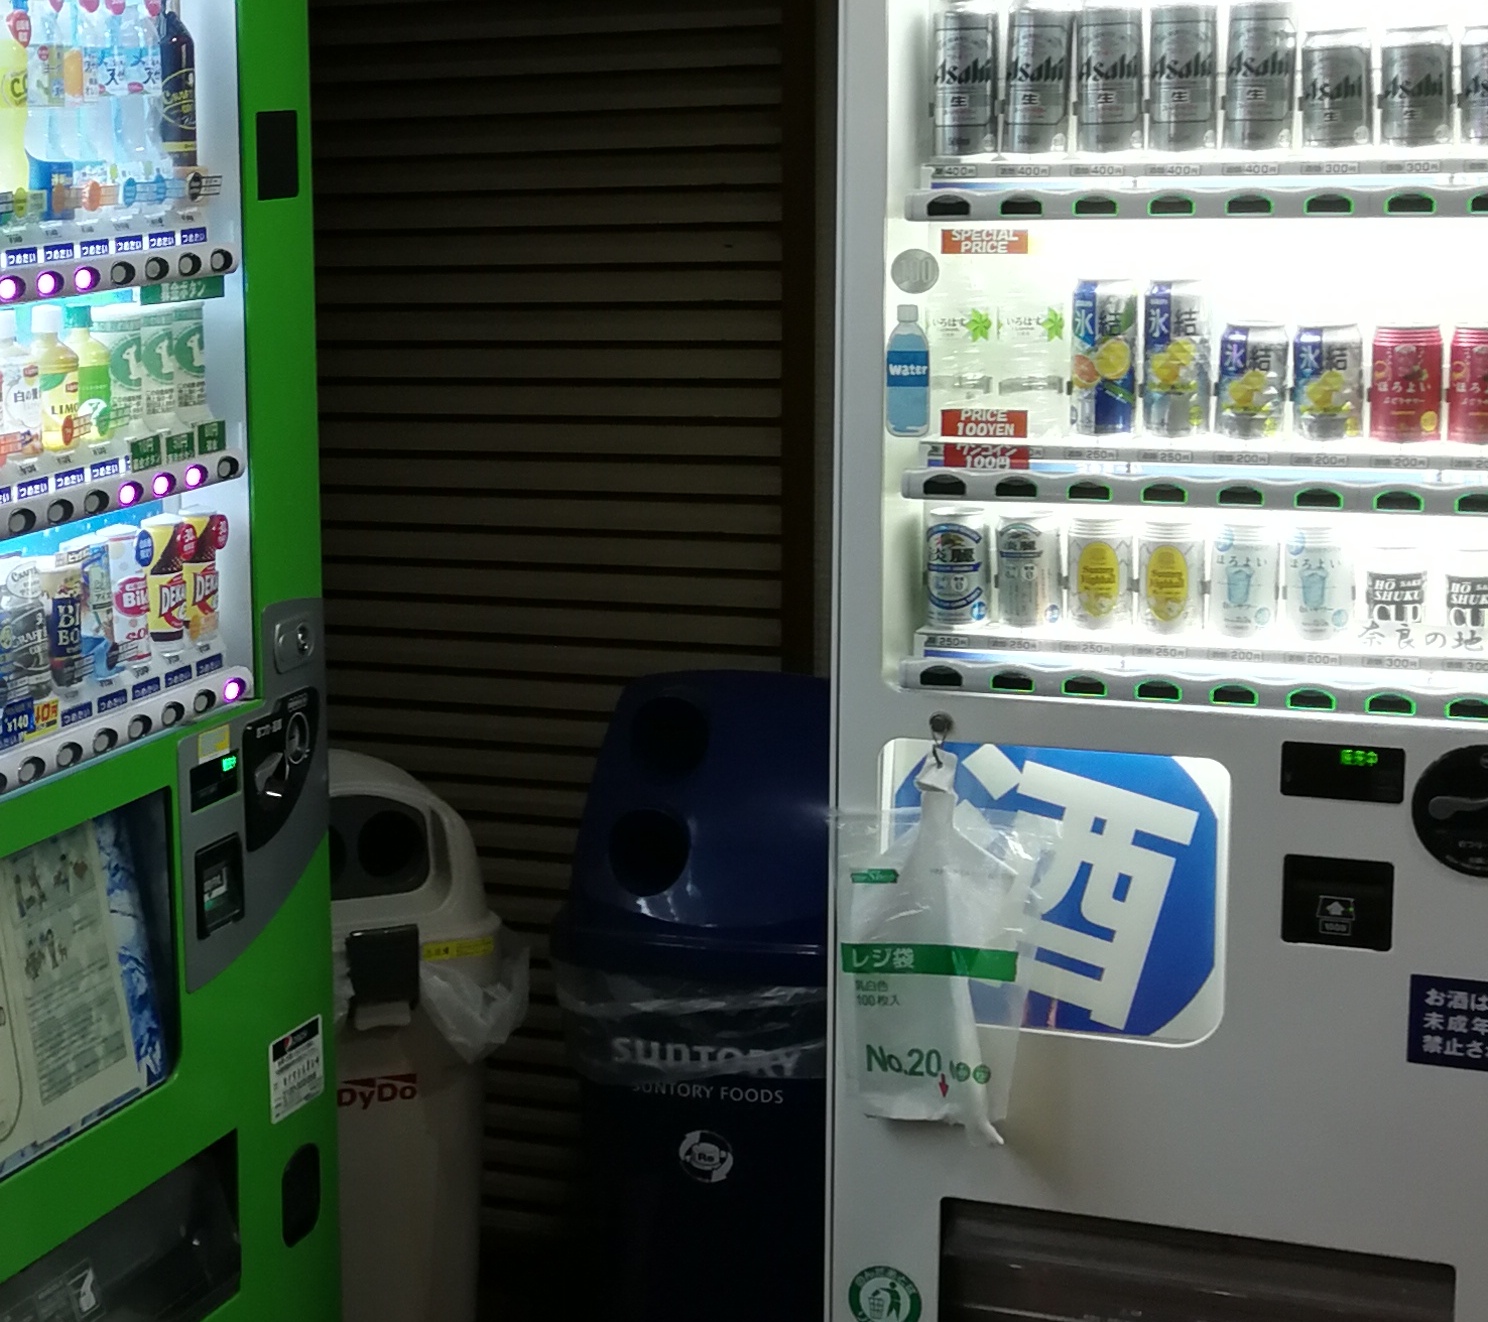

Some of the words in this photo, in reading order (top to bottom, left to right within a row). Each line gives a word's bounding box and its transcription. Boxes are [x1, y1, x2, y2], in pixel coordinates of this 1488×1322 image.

[961, 241, 1008, 254] PRICE
[888, 362, 929, 376] Water
[961, 409, 1008, 422] PRICE
[957, 422, 1015, 436] 100YEN
[965, 455, 1011, 470] 100円
[1358, 622, 1484, 652] 奈良の地
[850, 946, 916, 969] レジ袋
[855, 979, 889, 994] 乳白色
[855, 993, 901, 1008] 100枚入
[1424, 988, 1488, 1012] お酒は
[1422, 1011, 1488, 1036] 未成年
[865, 1044, 942, 1078] No.20
[337, 1081, 417, 1110] DyDo
[720, 1085, 784, 1105] FOODS
